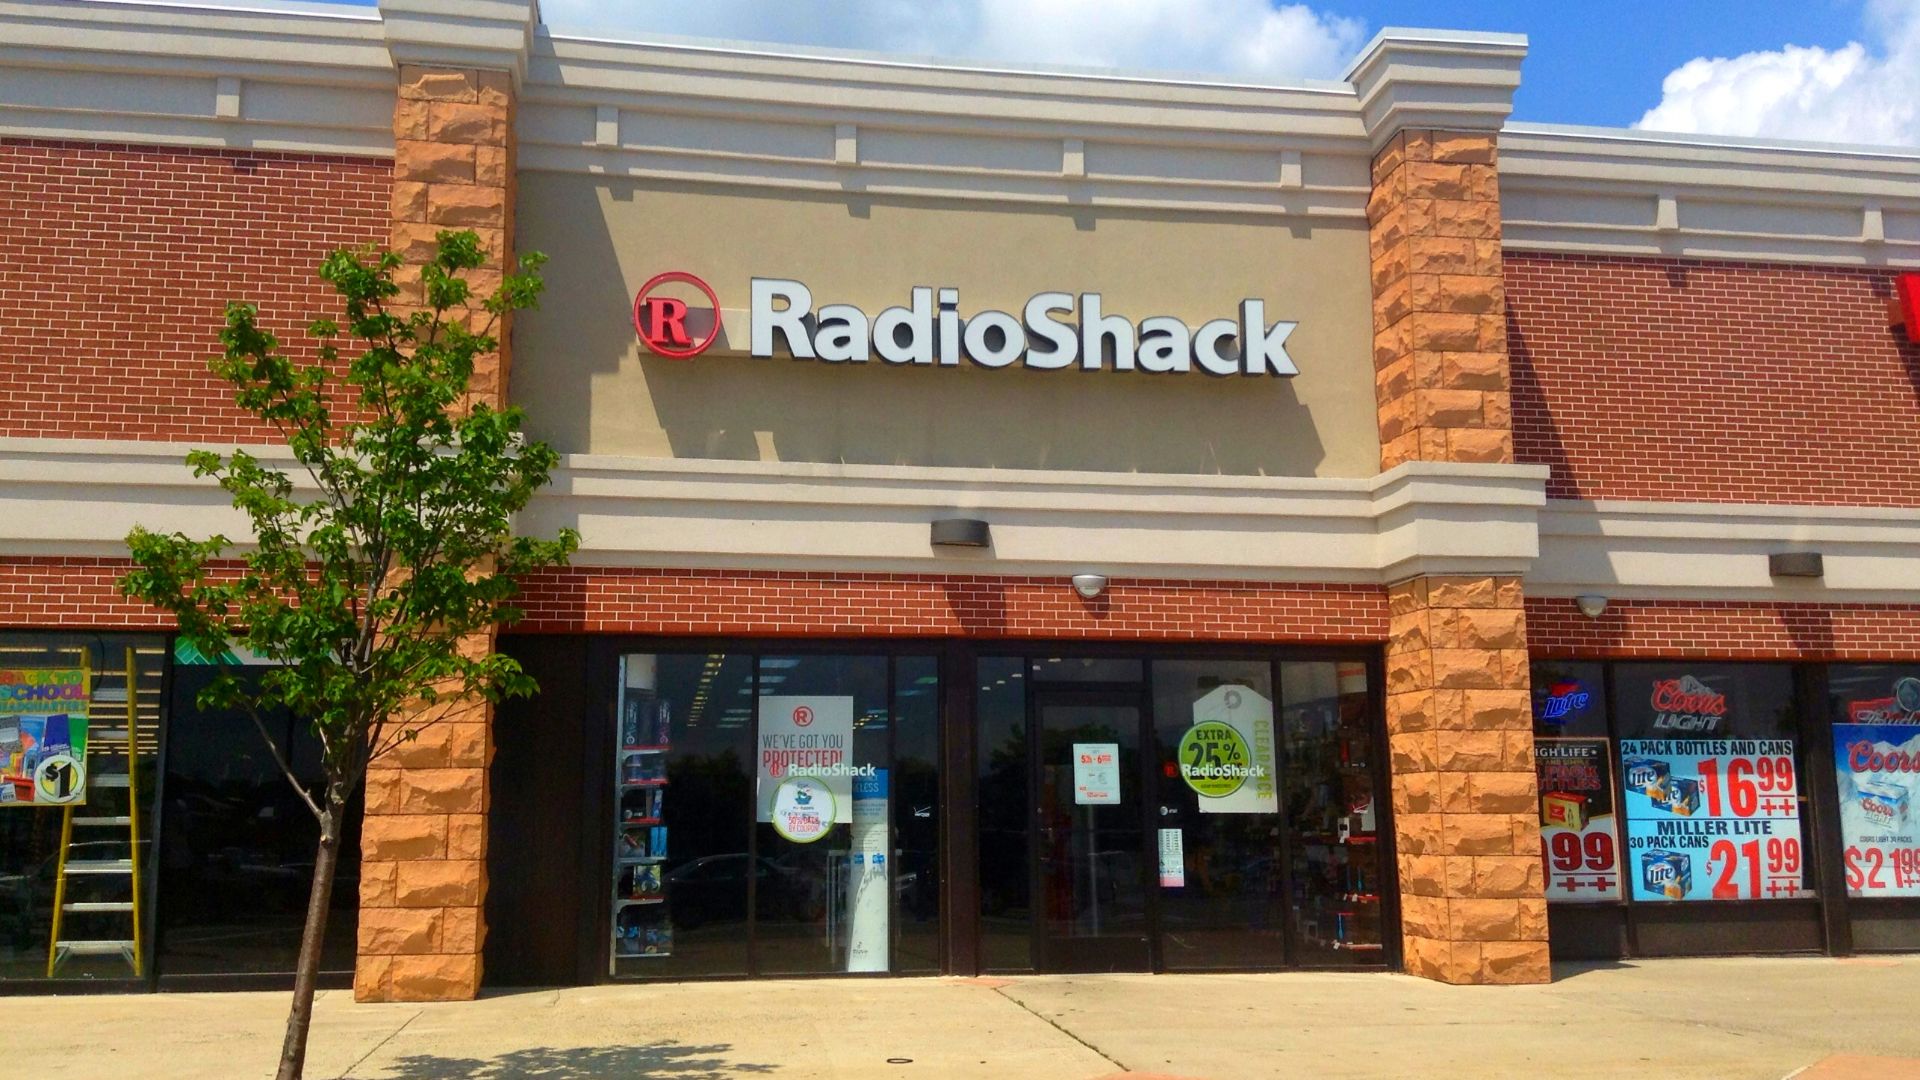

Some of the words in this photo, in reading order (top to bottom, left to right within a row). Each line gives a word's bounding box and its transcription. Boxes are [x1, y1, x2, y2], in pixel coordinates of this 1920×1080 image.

[750, 277, 1300, 376] RadioShack
[51, 671, 82, 685] TO
[0, 684, 90, 700] SCHOOL
[1652, 679, 1727, 715] Coors
[1653, 713, 1721, 730] LIGHT
[763, 734, 796, 748] WE'VE
[799, 734, 818, 748] GOT
[822, 734, 843, 748] YOU
[1196, 729, 1232, 740] EXTRA
[1535, 747, 1558, 757] IGH
[1561, 747, 1589, 757] LIFE
[1622, 742, 1637, 755] 24
[1640, 740, 1673, 756] PACK
[1675, 740, 1727, 756] BOTTLES
[1730, 740, 1756, 756] AND
[1759, 740, 1793, 755] CANS
[763, 750, 843, 768] PROTECTED!
[788, 763, 876, 777] RadioShack
[1182, 764, 1265, 777] RadioShack
[1657, 821, 1728, 835] MILLER
[1734, 821, 1772, 835] LITE
[1630, 837, 1644, 848] 30
[1647, 836, 1676, 848] PACK
[1679, 836, 1709, 848] CANS
